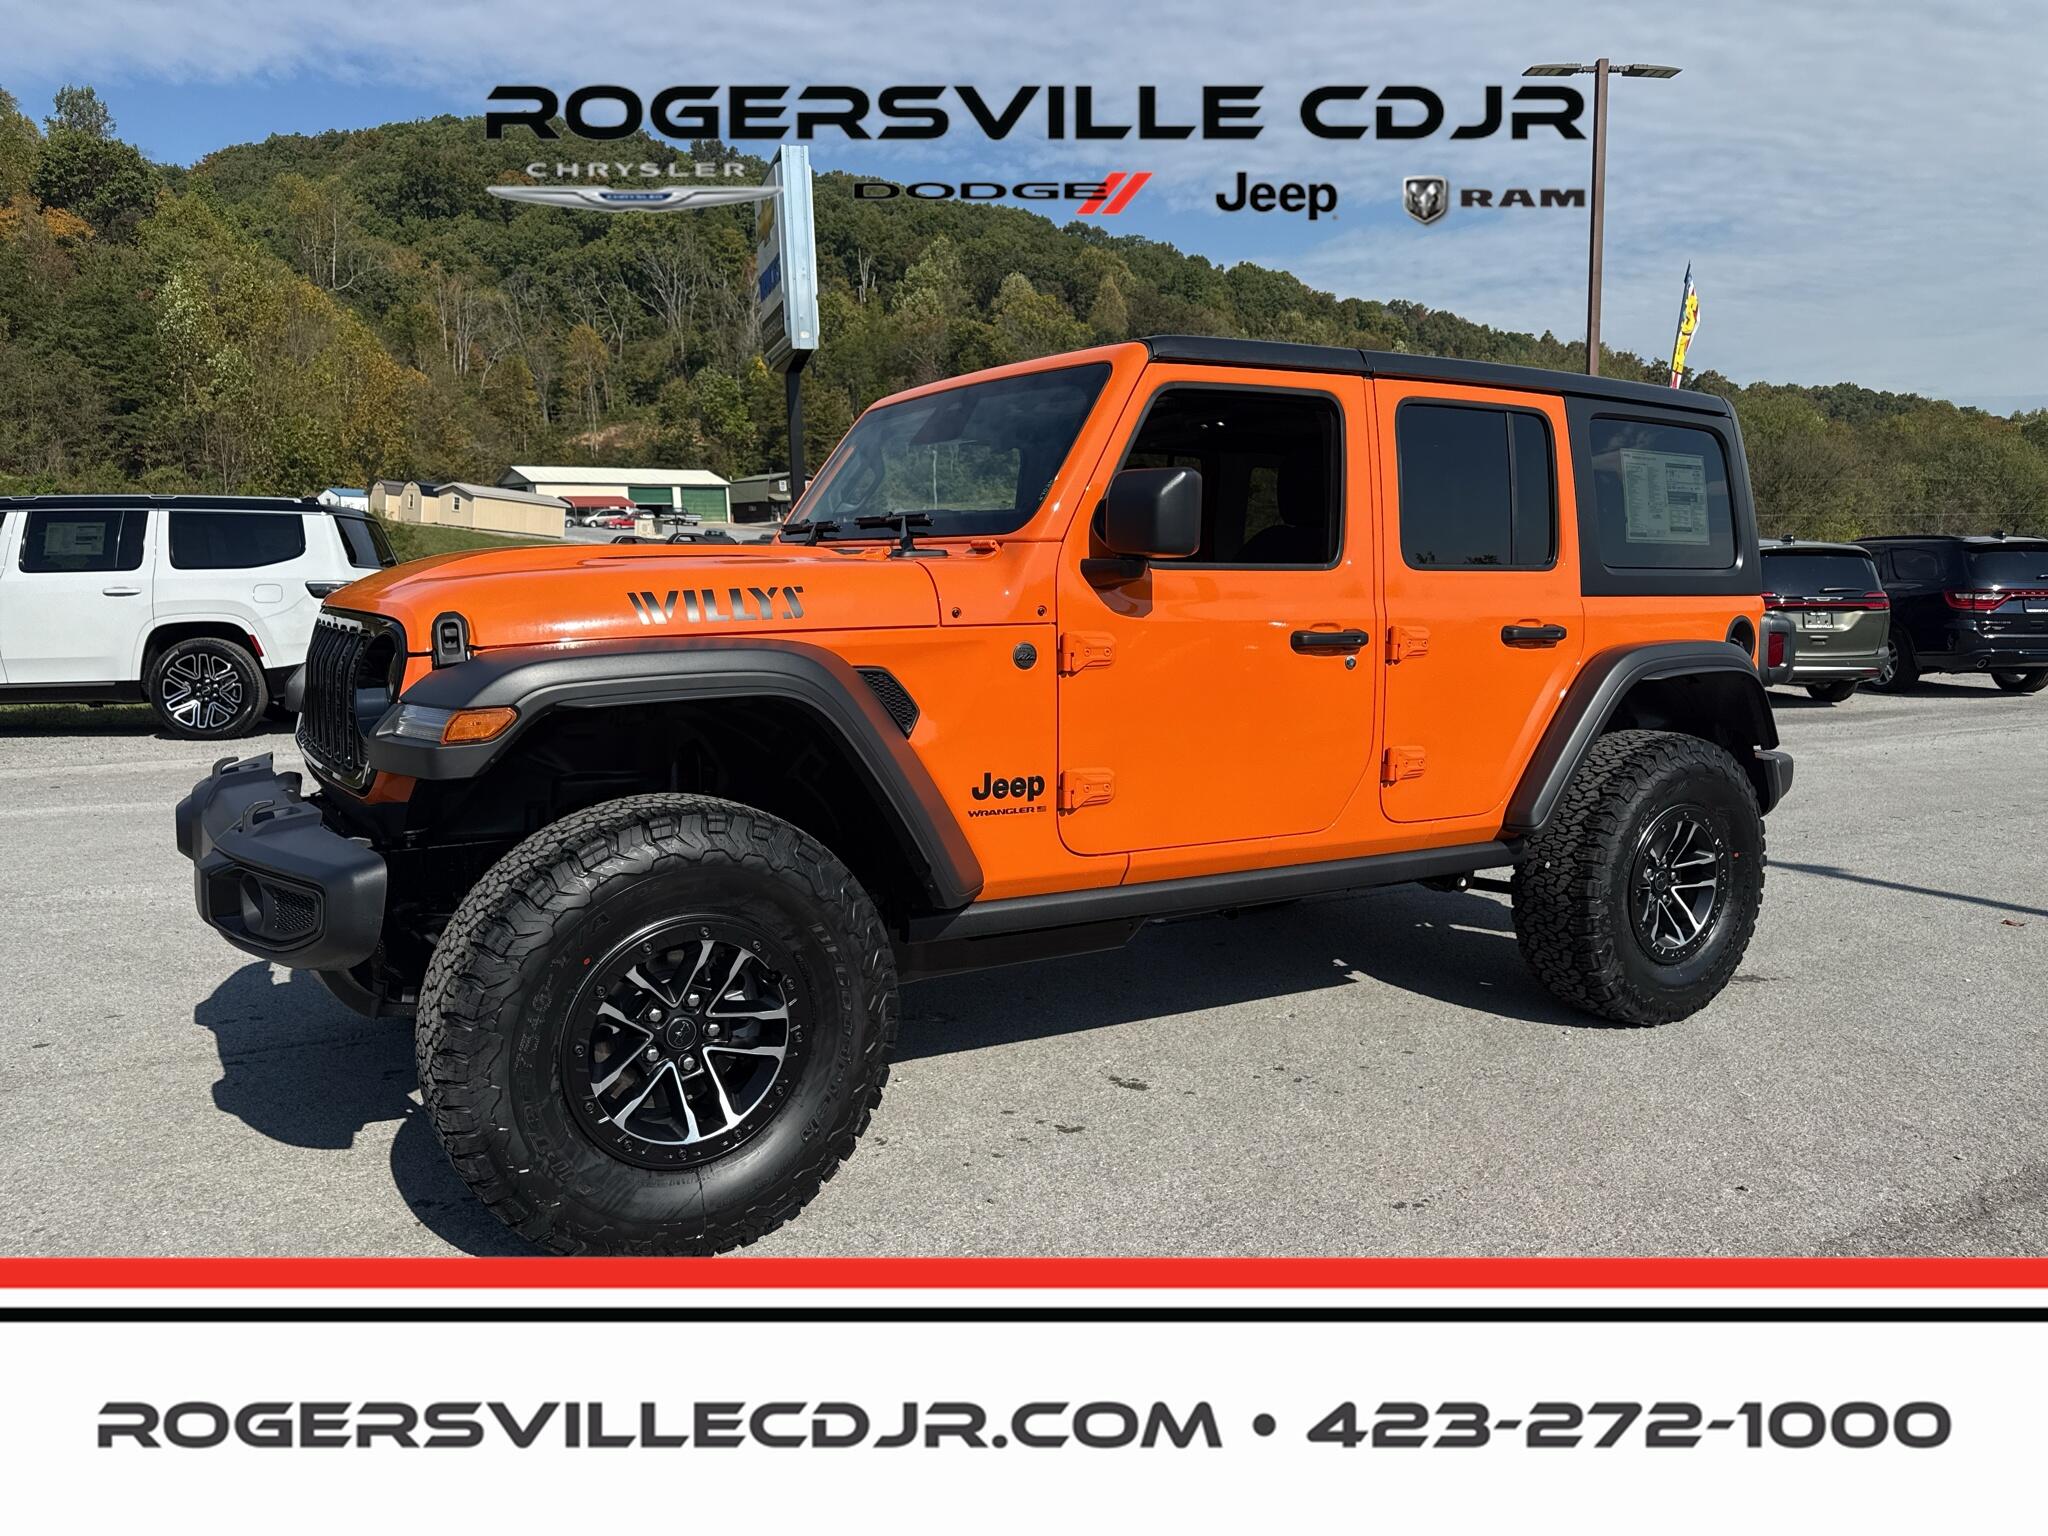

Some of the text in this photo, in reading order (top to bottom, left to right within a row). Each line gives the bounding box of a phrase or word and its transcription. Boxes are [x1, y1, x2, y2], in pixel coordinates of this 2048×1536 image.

[627, 586, 805, 625] WILLYS
[972, 772, 1045, 802] Jeep
[968, 806, 1035, 818] WRANGLER
